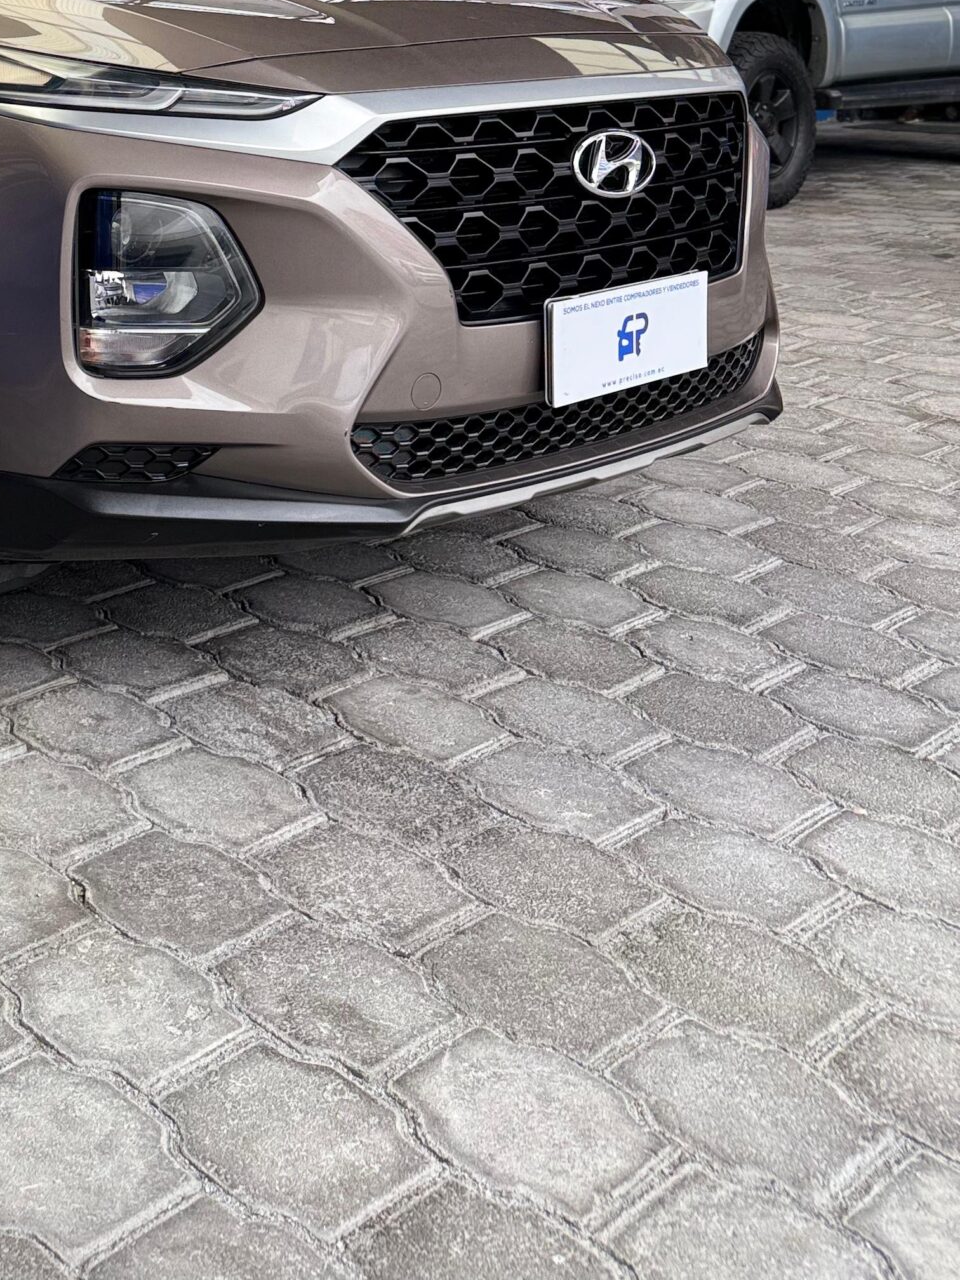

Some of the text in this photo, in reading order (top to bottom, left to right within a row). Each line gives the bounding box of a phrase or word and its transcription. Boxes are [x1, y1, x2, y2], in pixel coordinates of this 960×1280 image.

[563, 279, 700, 315] SOMOS EL NEXO ENTRE COMPRADORES Y VENDEDORES
